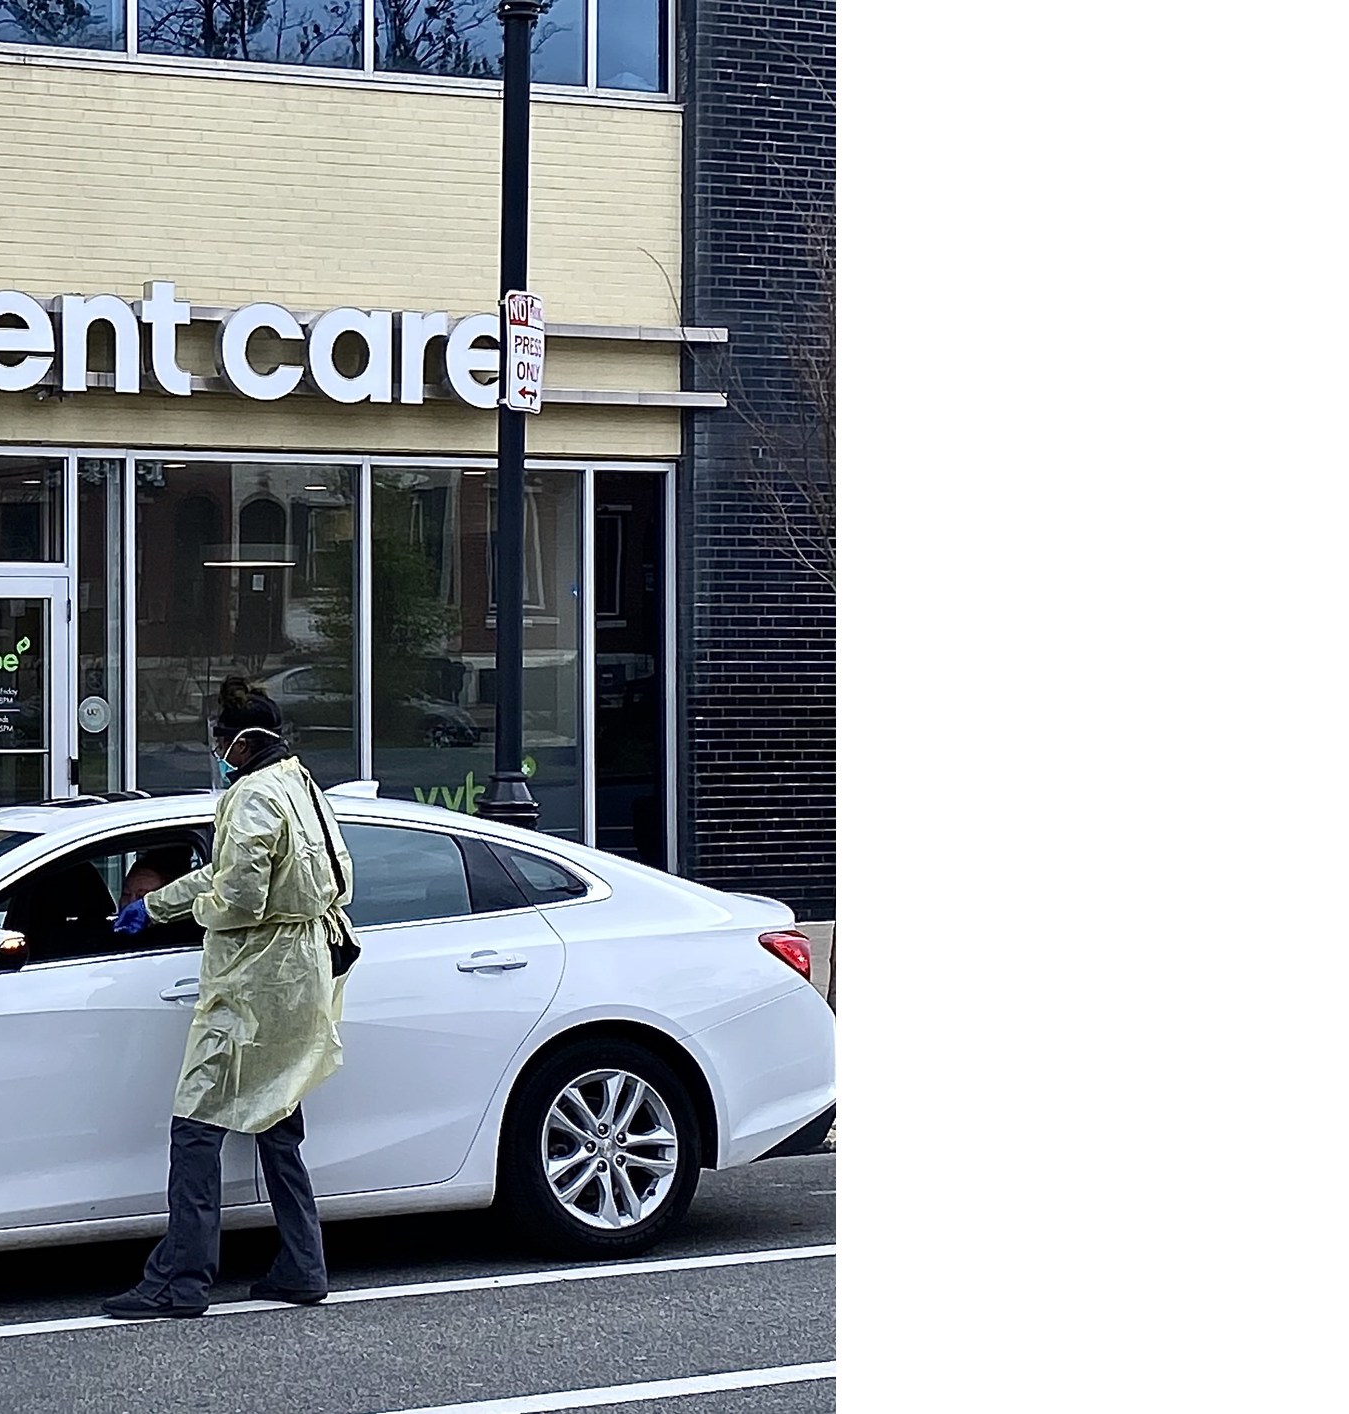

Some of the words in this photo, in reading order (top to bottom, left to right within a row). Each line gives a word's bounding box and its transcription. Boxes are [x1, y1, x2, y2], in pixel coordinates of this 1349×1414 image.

[509, 298, 527, 322] NO
[219, 302, 499, 409] care
[514, 334, 542, 358] PRESS
[516, 361, 541, 382] ONLY
